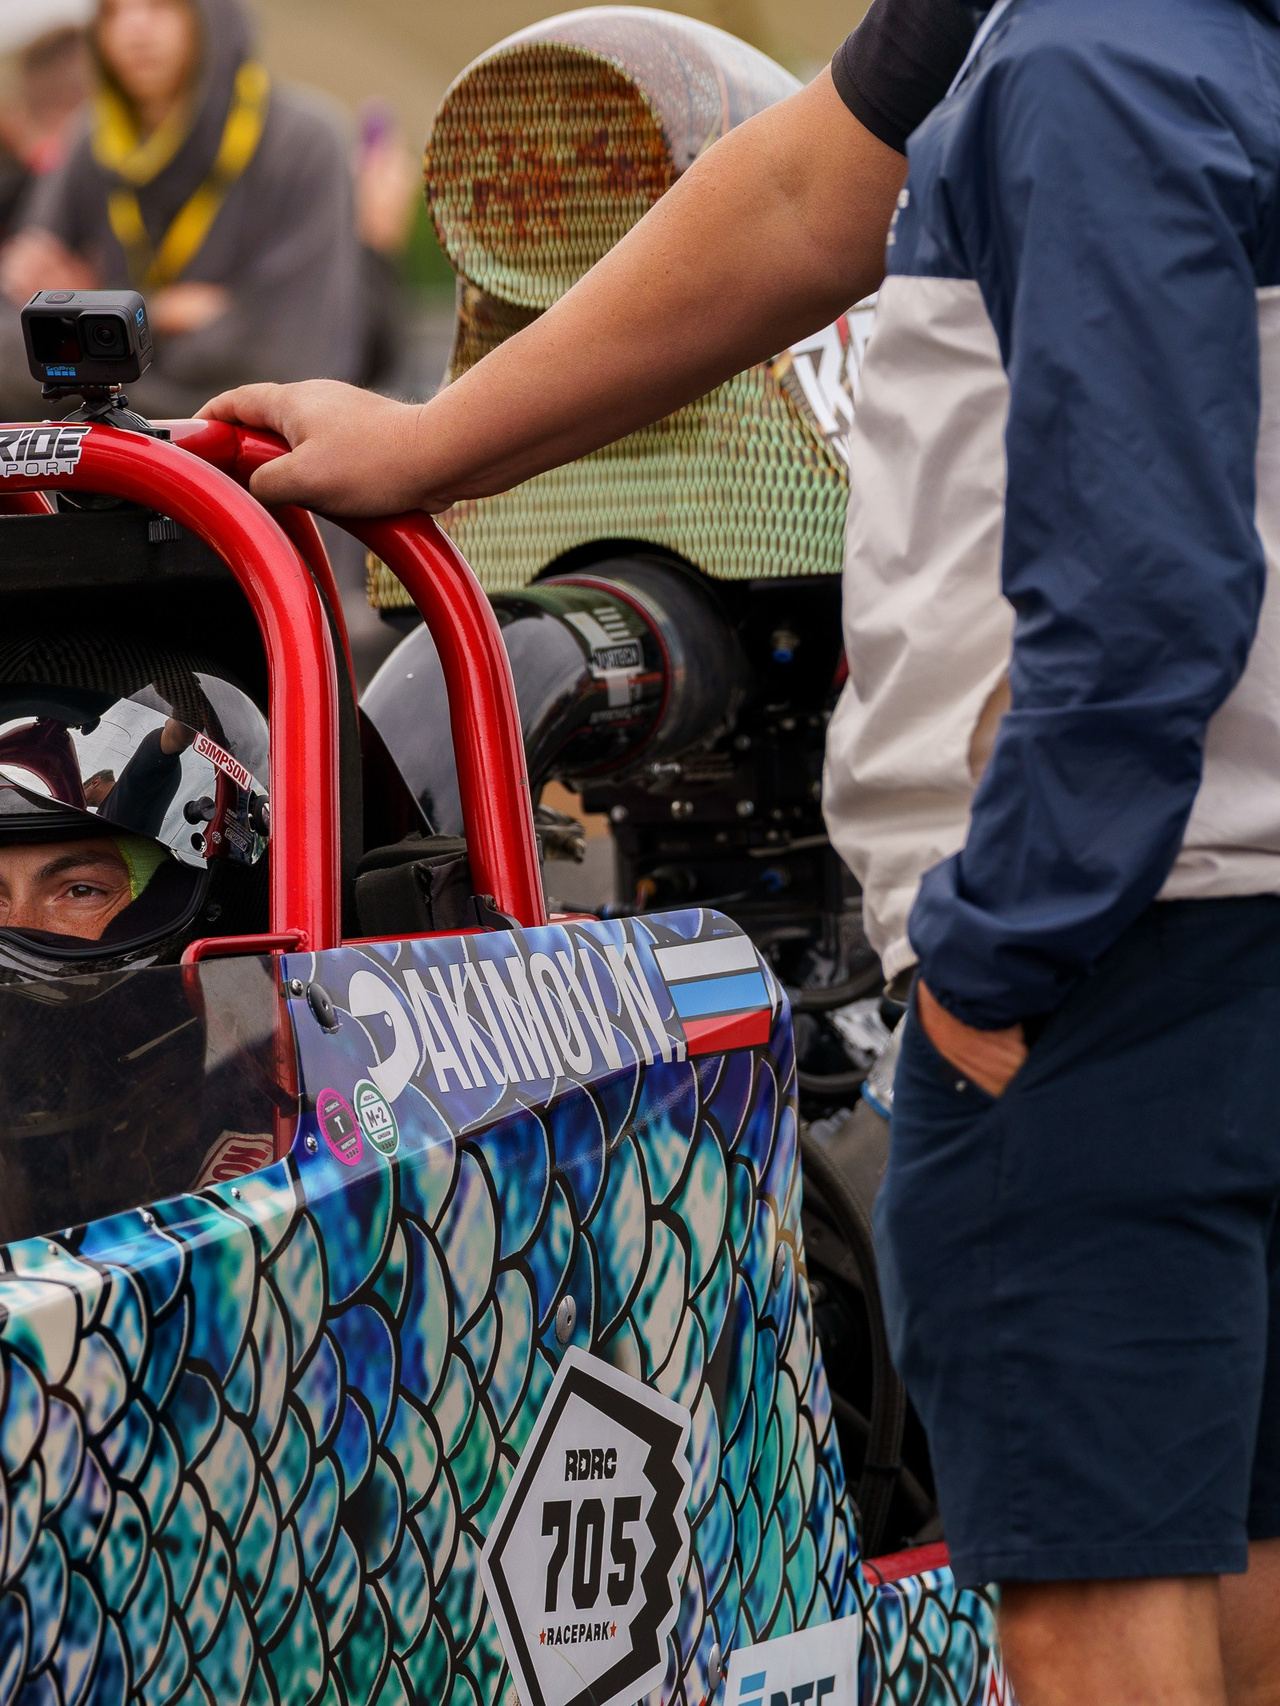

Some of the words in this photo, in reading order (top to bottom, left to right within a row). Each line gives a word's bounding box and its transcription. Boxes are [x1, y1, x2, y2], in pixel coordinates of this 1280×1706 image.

[197, 738, 249, 788] SIMPSON
[402, 948, 624, 1093] AKIMOV
[333, 1115, 345, 1134] T
[365, 1106, 388, 1129] M-2
[564, 1447, 618, 1482] RDRC
[541, 1495, 642, 1613] 705
[546, 1620, 611, 1646] RACEPARK
